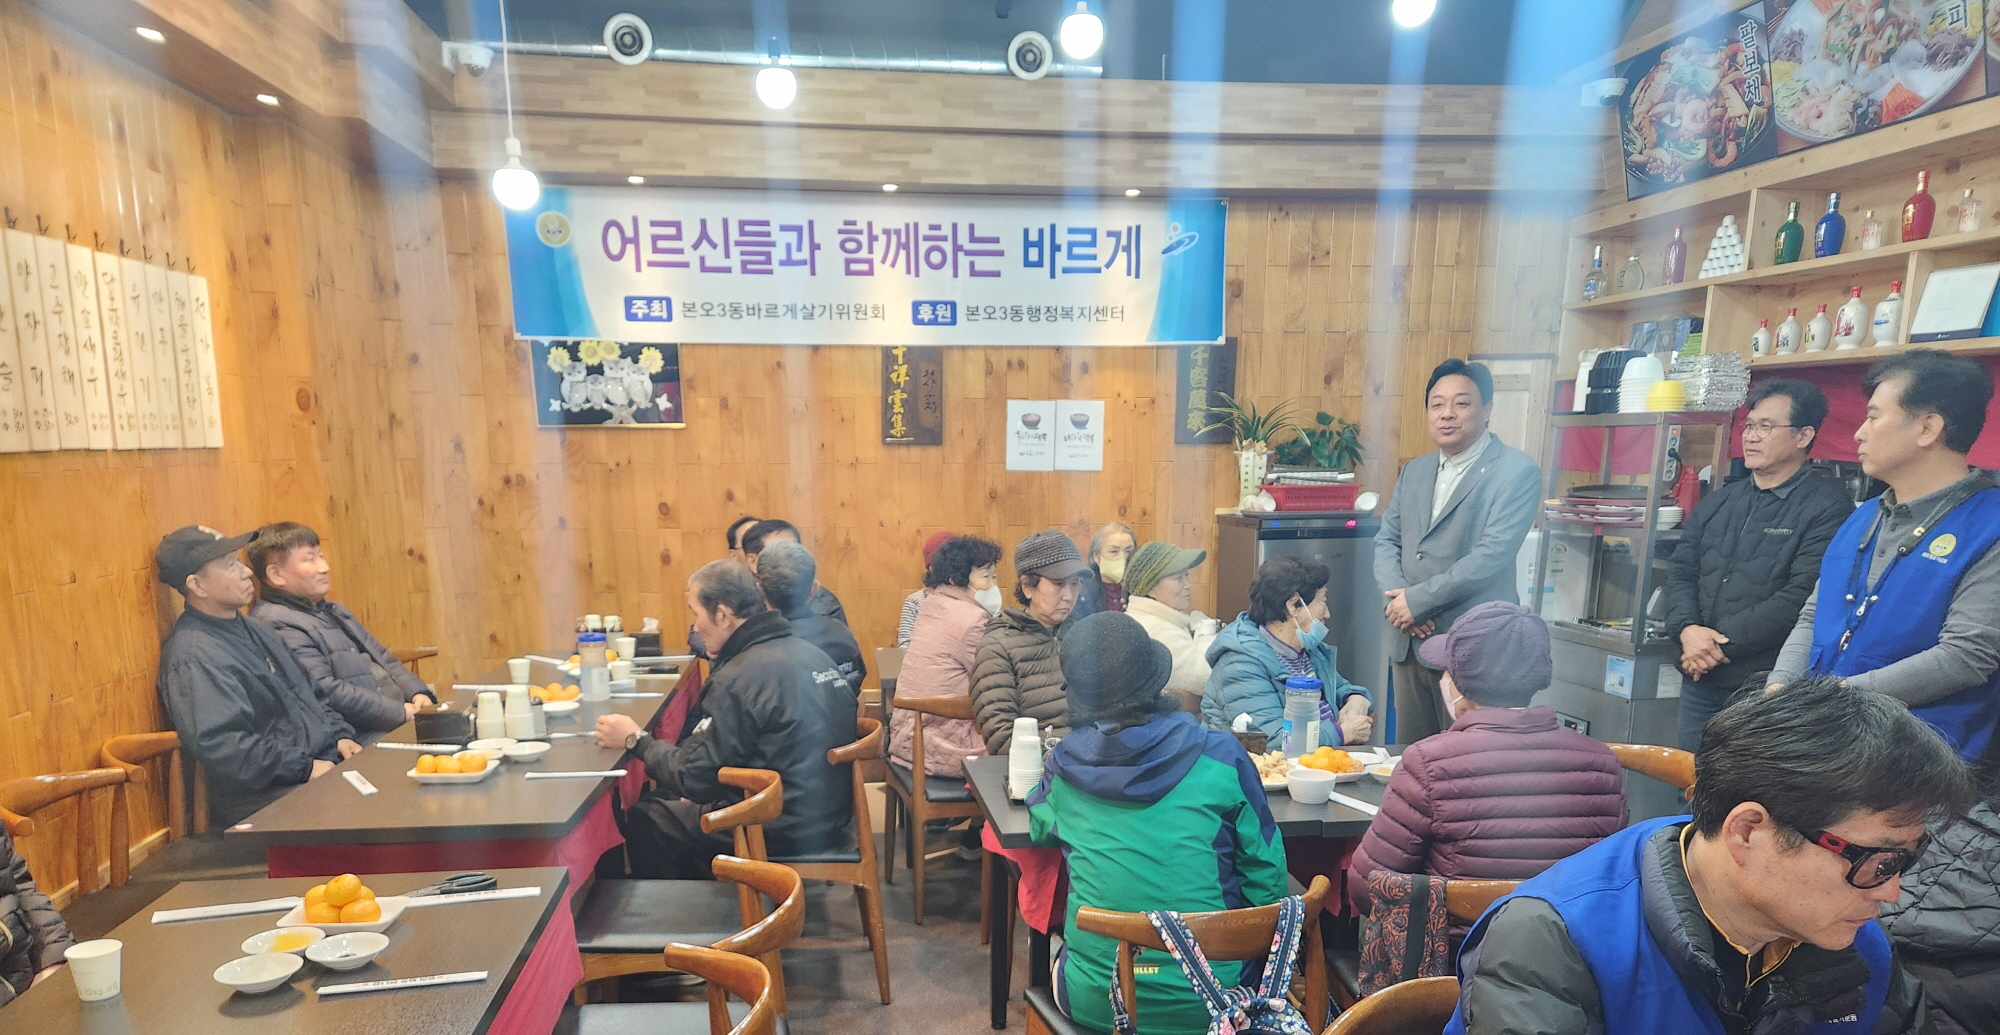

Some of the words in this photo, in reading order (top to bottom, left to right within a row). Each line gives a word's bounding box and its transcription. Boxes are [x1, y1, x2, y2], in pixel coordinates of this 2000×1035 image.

[1738, 19, 1762, 102] 팔보채
[602, 215, 821, 276] 어르신들과
[837, 219, 1005, 278] 함께하는
[1022, 222, 1142, 279] 바르게
[630, 299, 668, 320] 주최
[681, 301, 885, 321] 본오3동바르게살기위원회
[916, 303, 953, 323] 후원
[965, 303, 1125, 323] 본오3동행정복지센터
